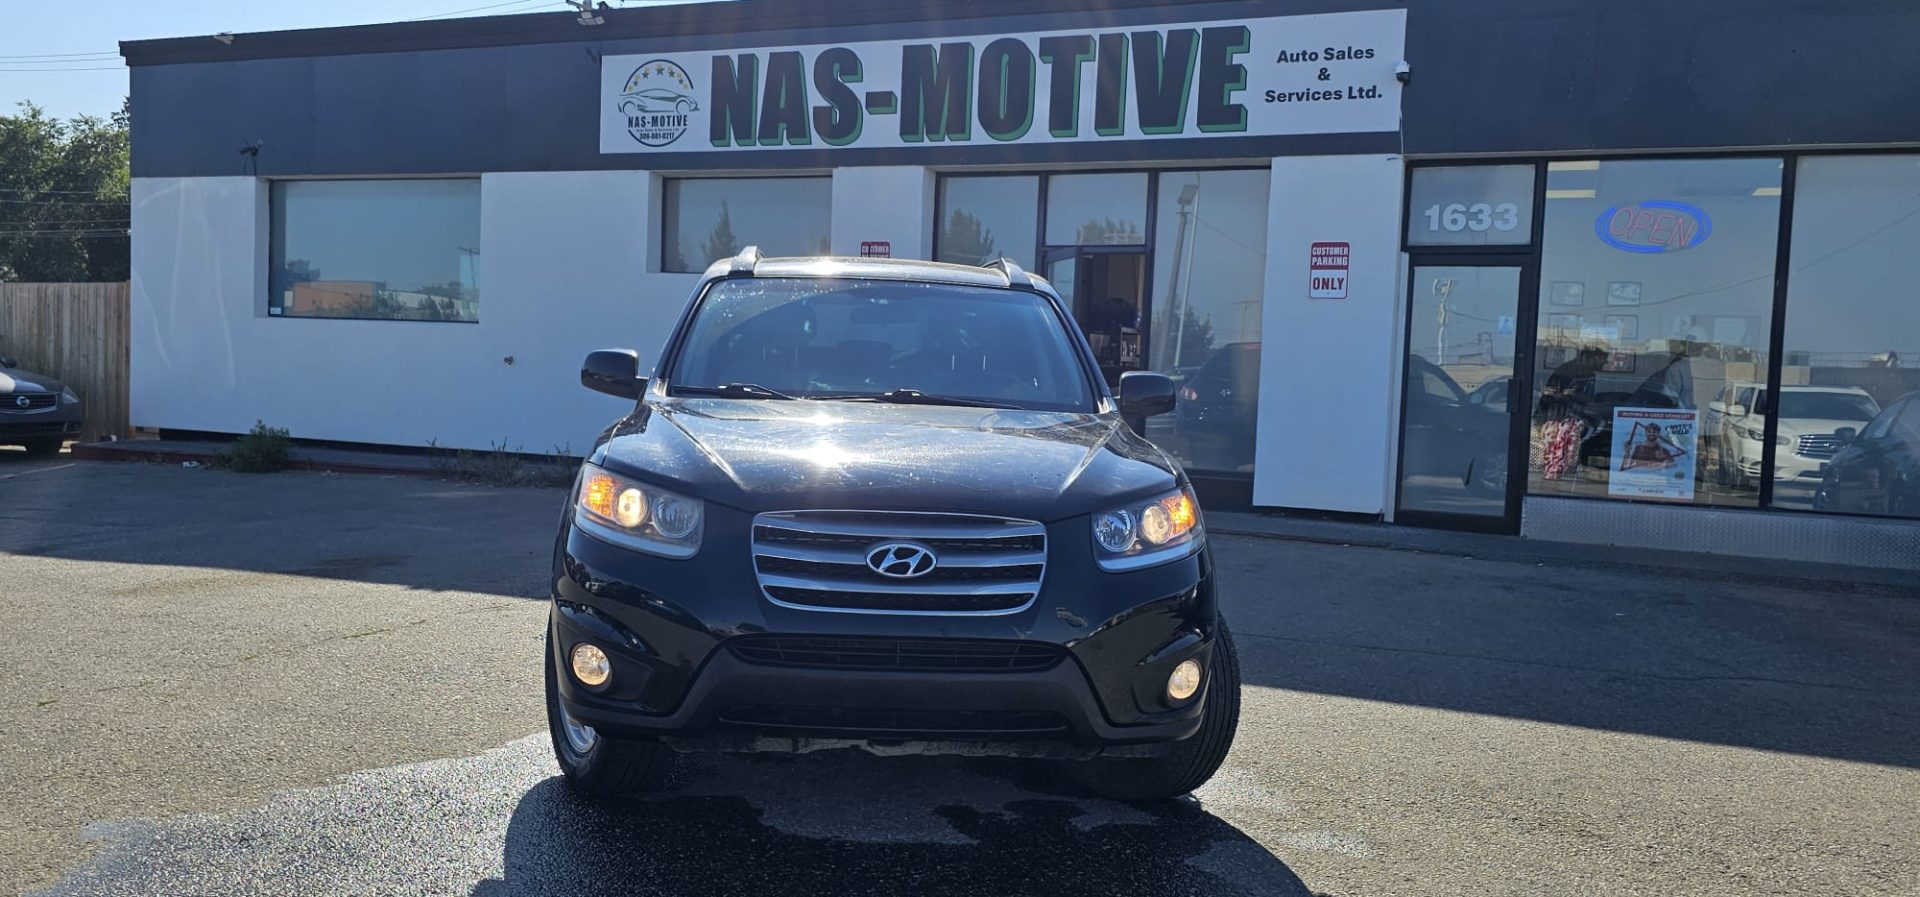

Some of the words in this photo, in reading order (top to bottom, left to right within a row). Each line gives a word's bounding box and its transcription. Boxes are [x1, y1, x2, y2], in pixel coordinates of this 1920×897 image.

[1277, 50, 1319, 63] Auto
[1323, 46, 1375, 61] Sales
[1317, 67, 1331, 81] &
[710, 26, 1251, 147] NAS-MOTIVE
[1264, 88, 1343, 103] Services
[1347, 85, 1382, 100] Ltd.
[628, 115, 688, 128] NAS-MOTIVE
[1424, 203, 1519, 232] 1633
[1609, 206, 1696, 249] OPEN
[1312, 247, 1349, 256] CUSTOMER
[1311, 256, 1348, 266] PARKING
[1312, 277, 1345, 290] ONLY
